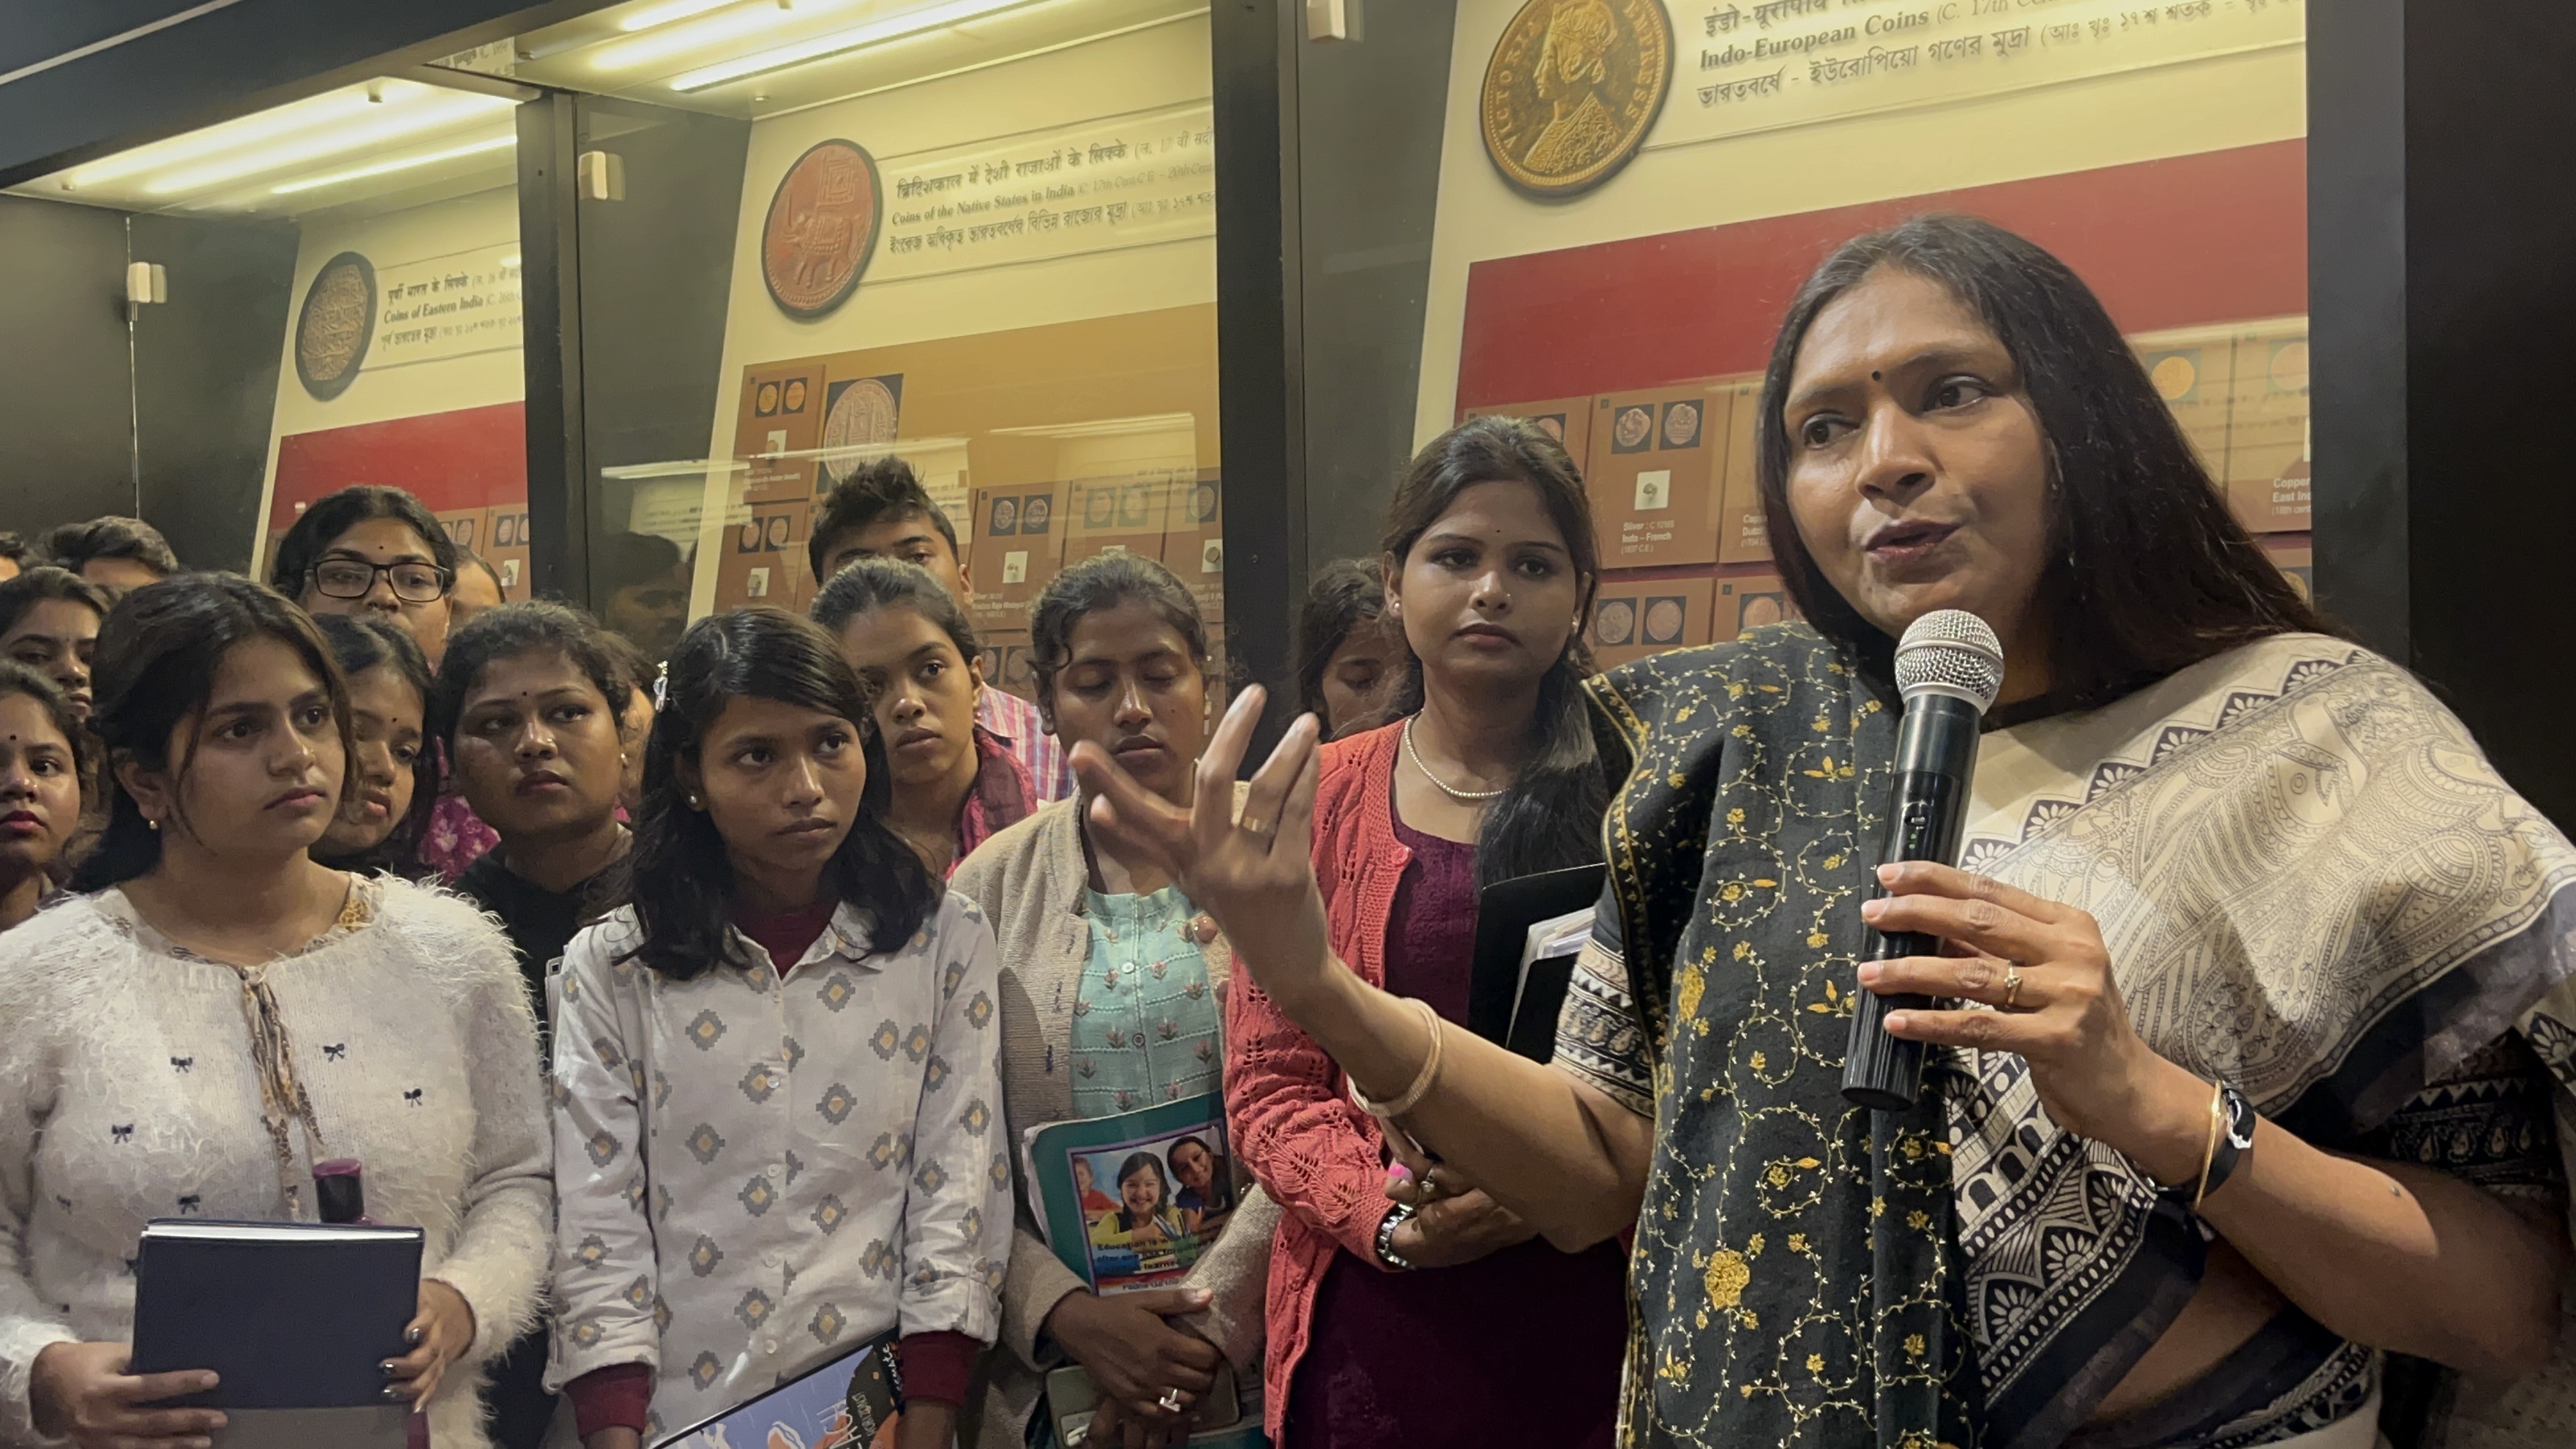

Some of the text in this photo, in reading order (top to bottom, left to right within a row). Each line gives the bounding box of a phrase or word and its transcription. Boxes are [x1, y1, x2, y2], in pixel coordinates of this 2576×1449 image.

[1699, 25, 1857, 70] Indo-European
[1865, 10, 1931, 36] Coins
[1936, 2, 1961, 24] (C.
[1696, 64, 1787, 108] ভারতবর্ষে
[1928, 34, 1983, 62] গণের
[1991, 25, 2031, 57] মুদ্রা
[968, 164, 981, 185] में
[984, 159, 1011, 185] देशी
[1014, 149, 1063, 178] राजाओं
[1067, 146, 1082, 168] के
[1088, 138, 1128, 165] सिक्के
[891, 211, 922, 226] Coins
[924, 206, 936, 221] of
[937, 204, 954, 218] the
[956, 199, 991, 216] Native
[994, 195, 1028, 209] States
[1031, 190, 1043, 202] in
[1045, 184, 1076, 201] India
[407, 282, 429, 298] भारत
[431, 275, 441, 293] के
[384, 310, 408, 325] Coins
[411, 304, 422, 319] of
[422, 301, 457, 317] Eastern
[460, 294, 484, 310] India
[2272, 491, 2295, 503] East
[2273, 476, 2311, 490] Copper
[1623, 520, 1644, 531] Silver
[1646, 531, 1673, 542] French
[815, 1399, 863, 1449] ACH
